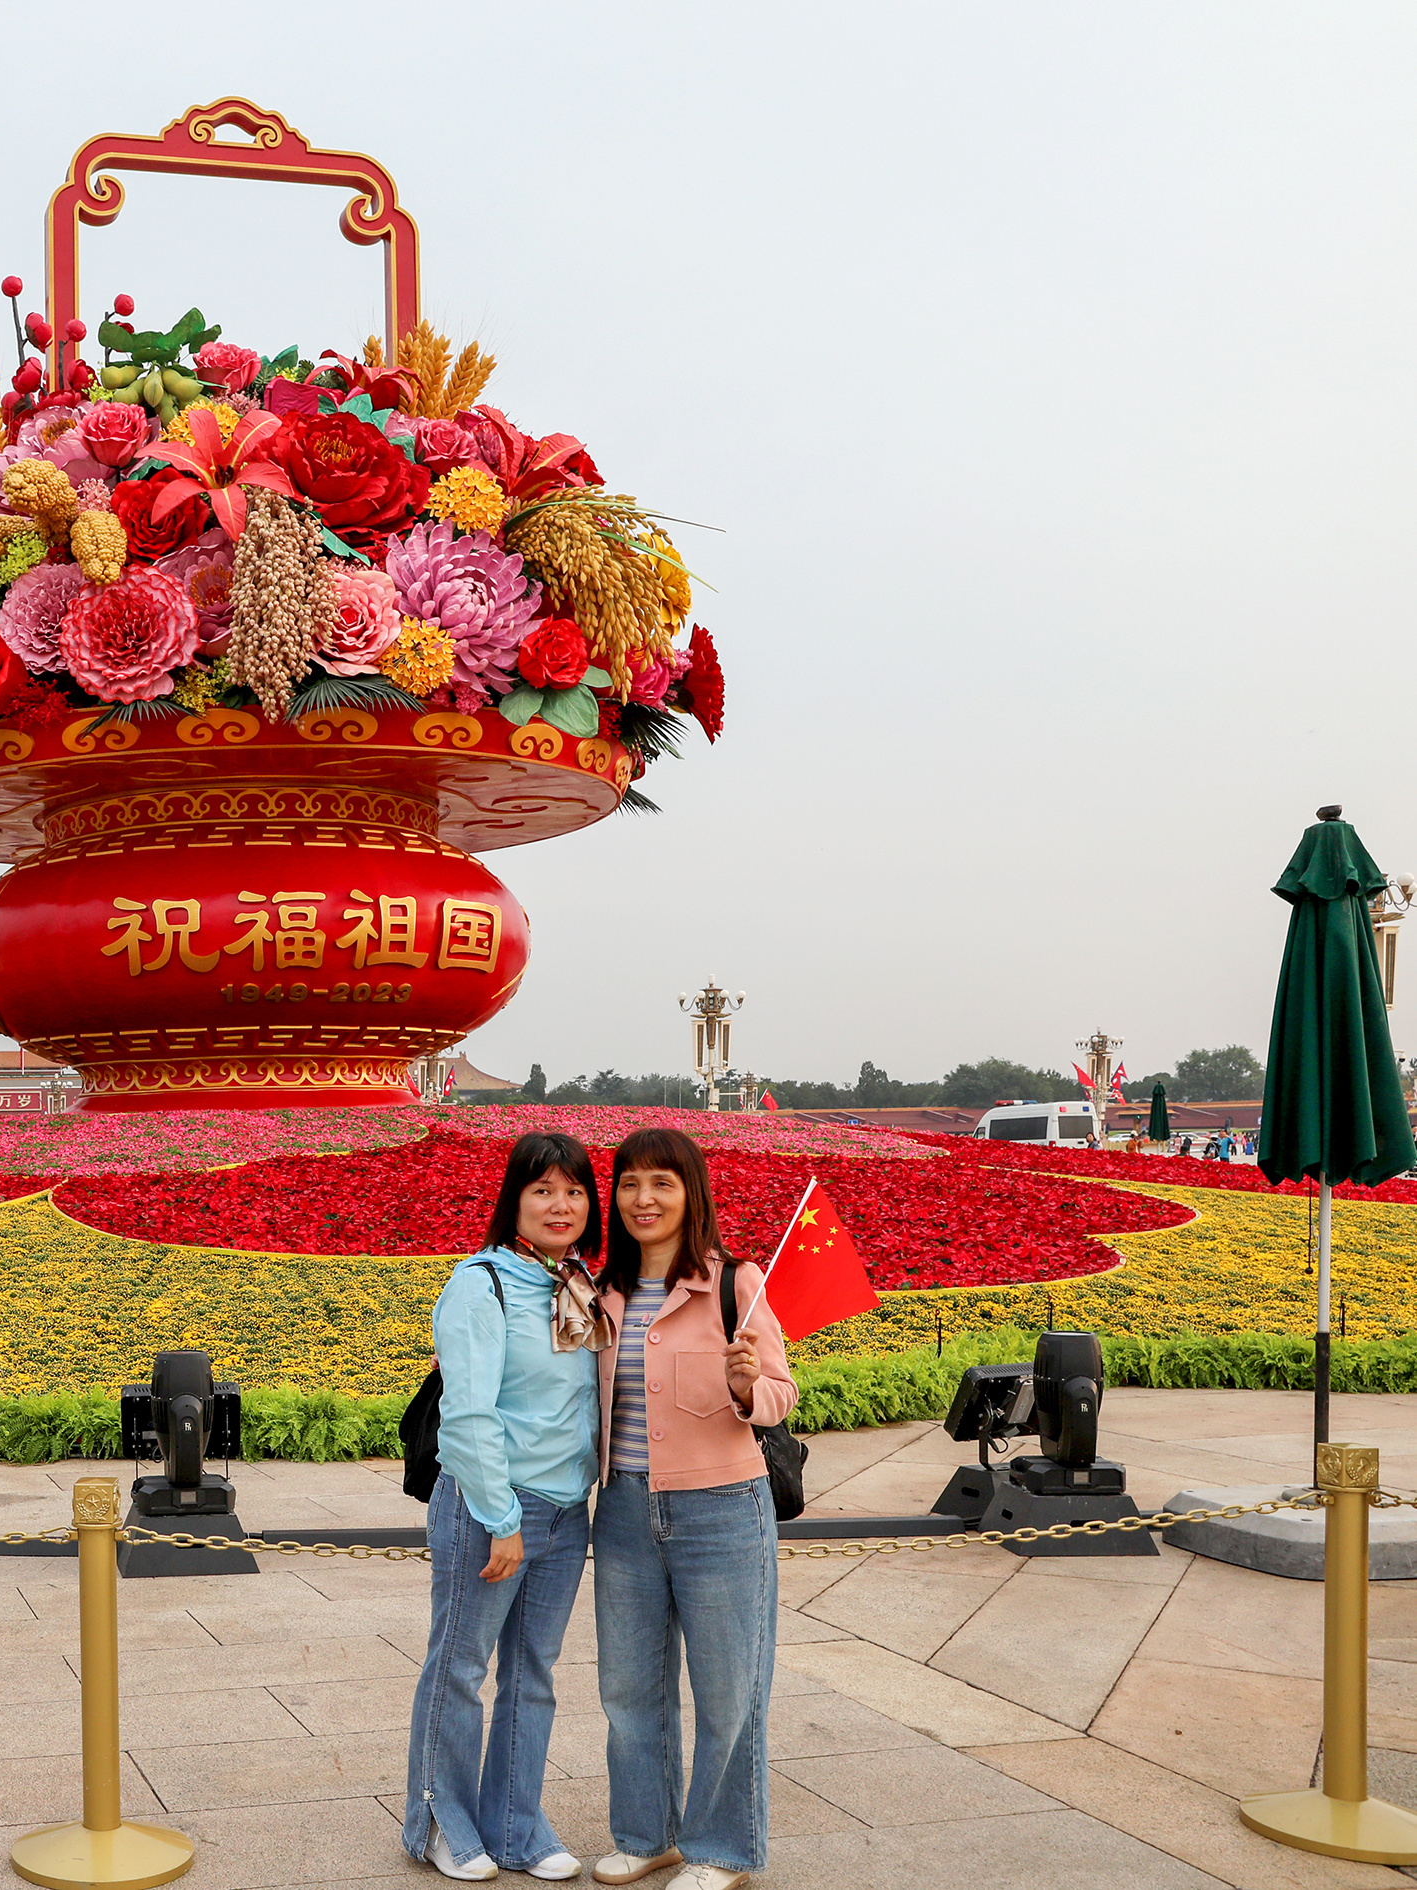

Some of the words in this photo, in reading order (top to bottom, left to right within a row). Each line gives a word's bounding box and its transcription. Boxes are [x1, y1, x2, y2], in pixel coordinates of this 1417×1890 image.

[100, 889, 503, 976] 祝福祖国
[221, 982, 413, 1003] 1949-2023
